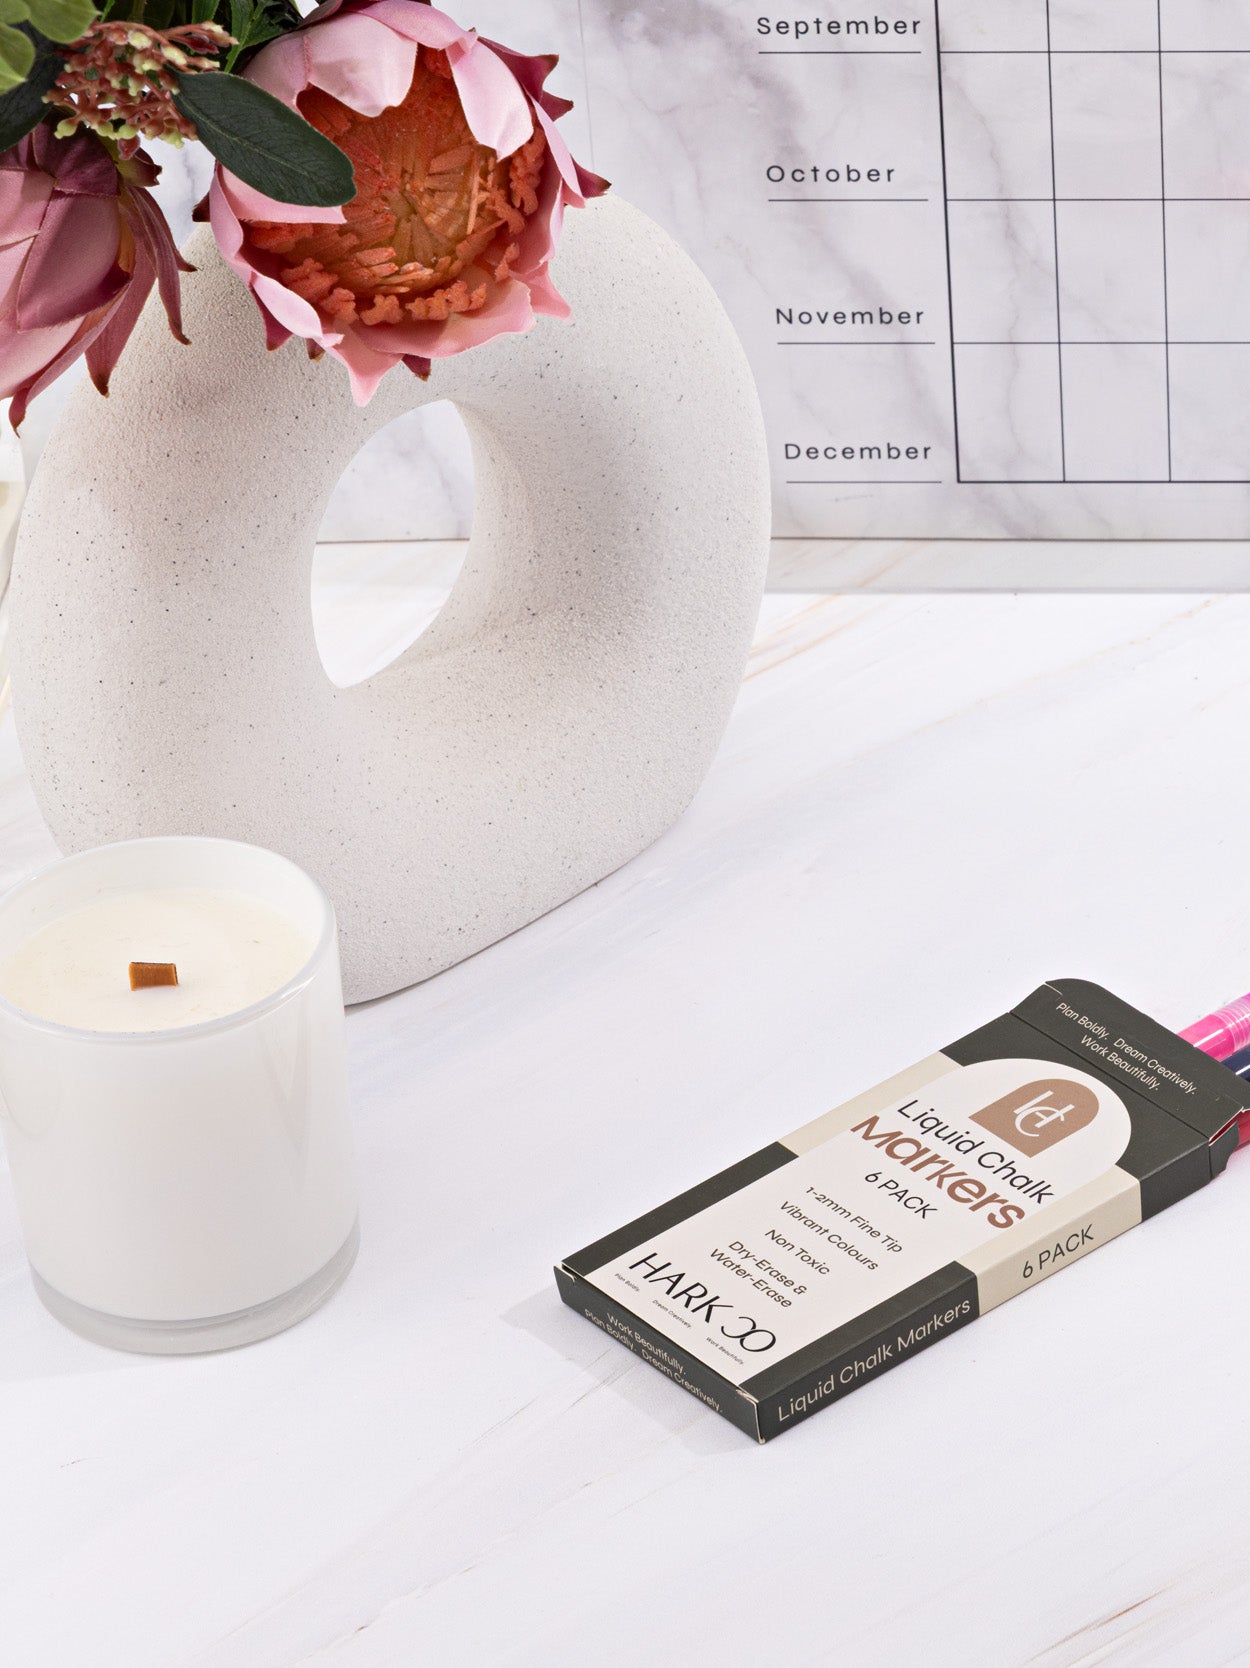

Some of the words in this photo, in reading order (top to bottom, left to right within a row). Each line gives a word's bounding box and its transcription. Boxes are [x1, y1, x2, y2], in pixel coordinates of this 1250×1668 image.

[757, 16, 921, 40] September
[766, 164, 895, 183] October
[775, 307, 924, 325] November
[784, 442, 932, 460] December
[1056, 1002, 1079, 1021] Plan
[1077, 1016, 1110, 1040] Boldly.
[1114, 1038, 1147, 1063] Dream
[1147, 1059, 1197, 1094] Creatively.
[1080, 1035, 1109, 1057] Work
[1107, 1052, 1160, 1091] Beautifully.
[850, 1115, 1026, 1229] Markers
[897, 1100, 985, 1155] Liquid
[977, 1151, 1054, 1204] Chalk
[805, 1186, 852, 1219] 1-2mm
[850, 1215, 881, 1238] Fine
[881, 1235, 903, 1253] Tip
[864, 1171, 882, 1183] 6
[878, 1179, 938, 1219] PACK
[765, 1229, 795, 1251] Non
[795, 1247, 830, 1275] Toxic
[780, 1201, 829, 1236] Vibrant
[827, 1234, 879, 1270] Colours
[1022, 1262, 1034, 1279] 6
[1038, 1224, 1095, 1271] PACK
[628, 1252, 734, 1323] HARK
[710, 1249, 792, 1308] Water-Erase
[728, 1241, 795, 1288] Dry-Erase
[793, 1285, 808, 1295] &
[584, 1309, 605, 1329] Plan
[606, 1324, 637, 1351] Boldly.
[641, 1349, 674, 1378] Dream
[674, 1372, 723, 1413] Creatively.
[607, 1313, 634, 1337] Work
[634, 1332, 687, 1375] Beautifully.
[777, 1375, 835, 1422] Liquid
[839, 1343, 894, 1384] Chalk
[897, 1299, 971, 1352] Markers
